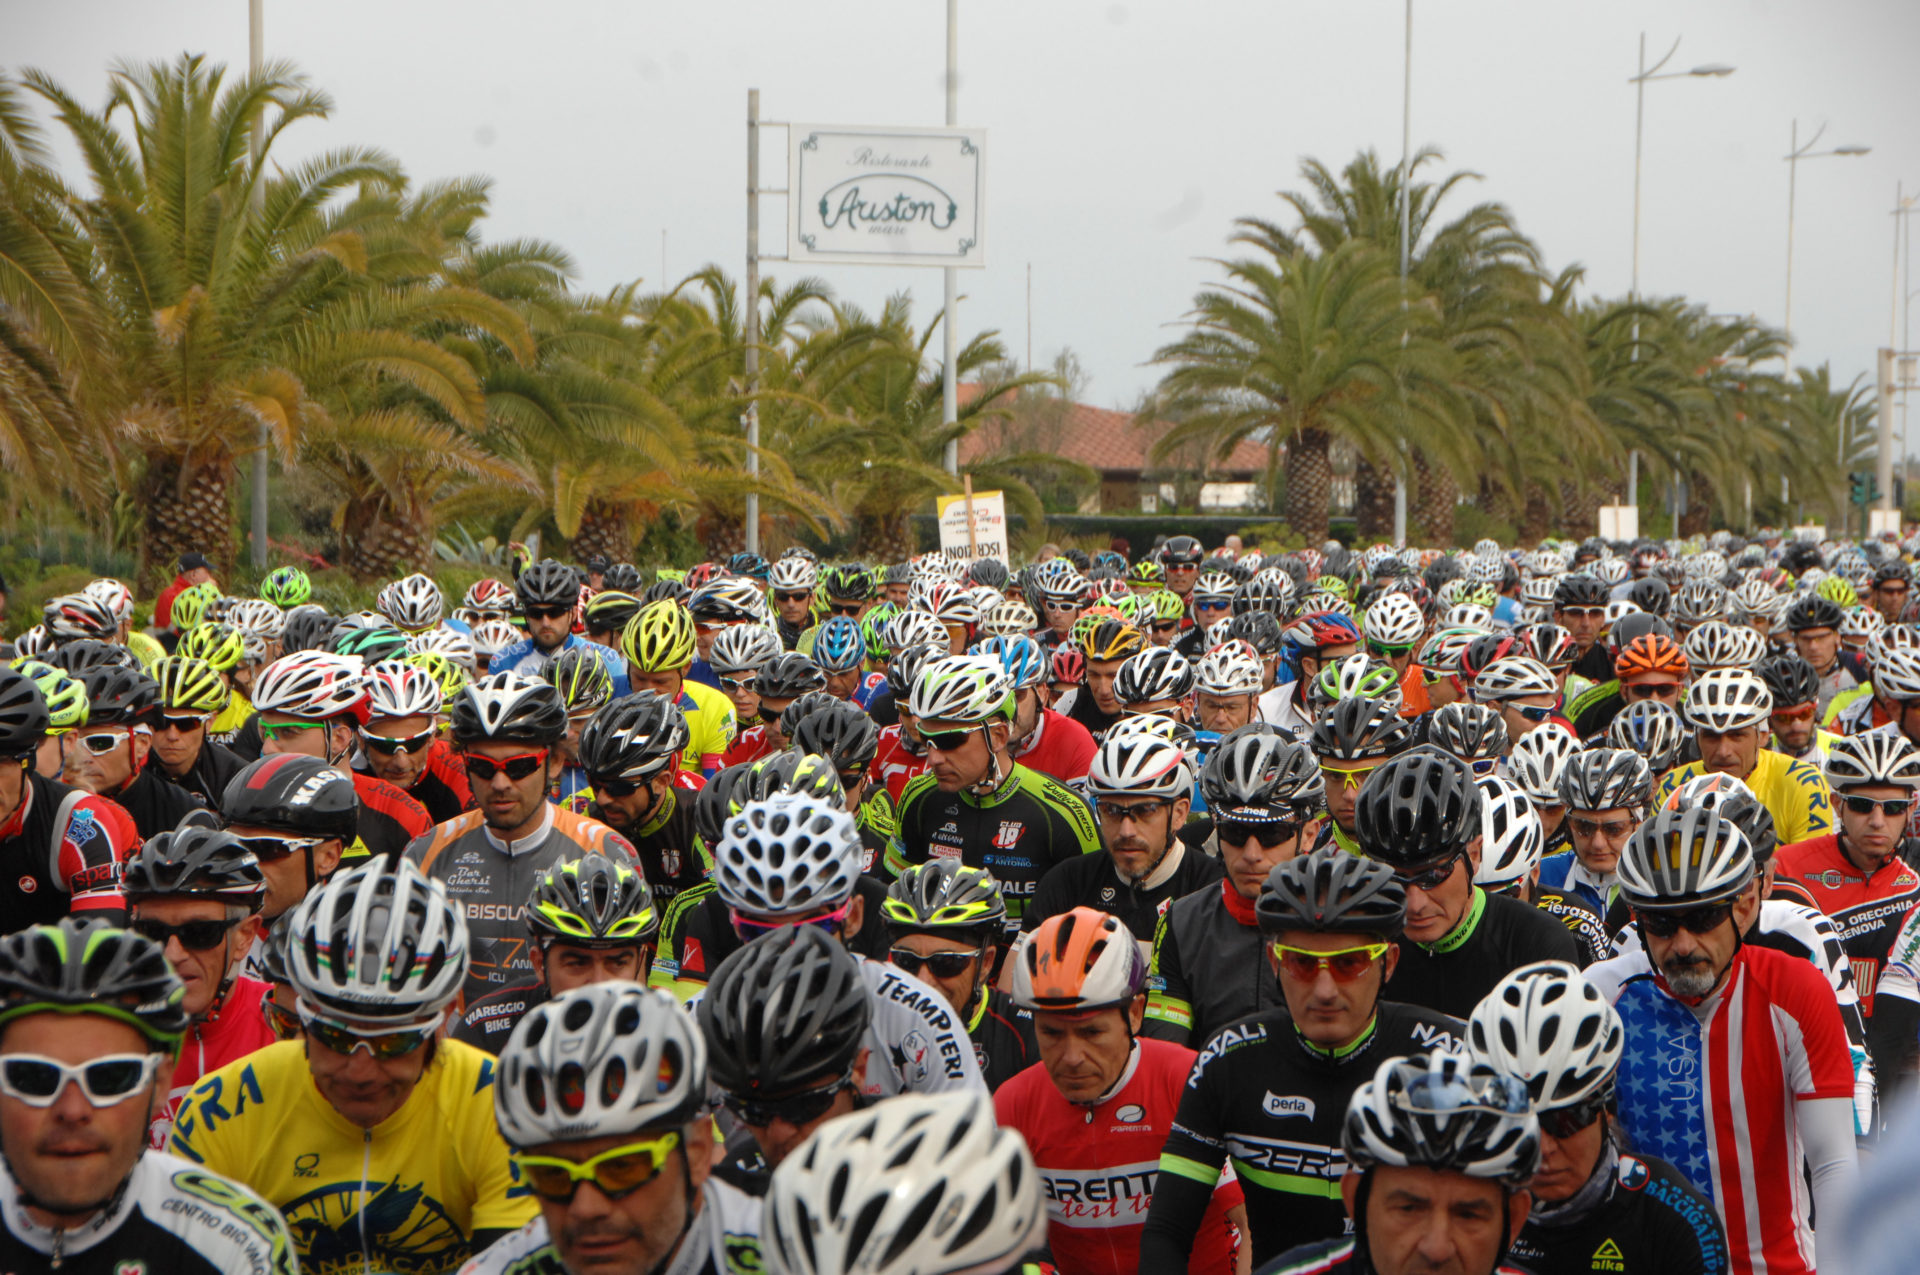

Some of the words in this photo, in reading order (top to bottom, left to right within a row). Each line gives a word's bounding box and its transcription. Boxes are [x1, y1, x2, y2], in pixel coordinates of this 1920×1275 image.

[846, 147, 932, 168] Ristorante
[832, 186, 942, 230] Ariston
[1785, 760, 1829, 832] VIFRA
[447, 875, 491, 886] Ghersi
[457, 867, 481, 877] Bar
[1848, 900, 1914, 926] ORECCHIA
[1838, 919, 1886, 942] GENOVA
[465, 1001, 526, 1026] VIAREGGIO
[485, 1018, 511, 1034] BIKE
[1668, 1033, 1696, 1101] USA
[169, 1063, 264, 1164] IFRA
[1271, 1097, 1306, 1111] perla
[1062, 1195, 1120, 1219] test
[161, 1198, 222, 1229] CENTRO
[220, 1223, 249, 1245] BICI
[1591, 1259, 1624, 1272] alka
